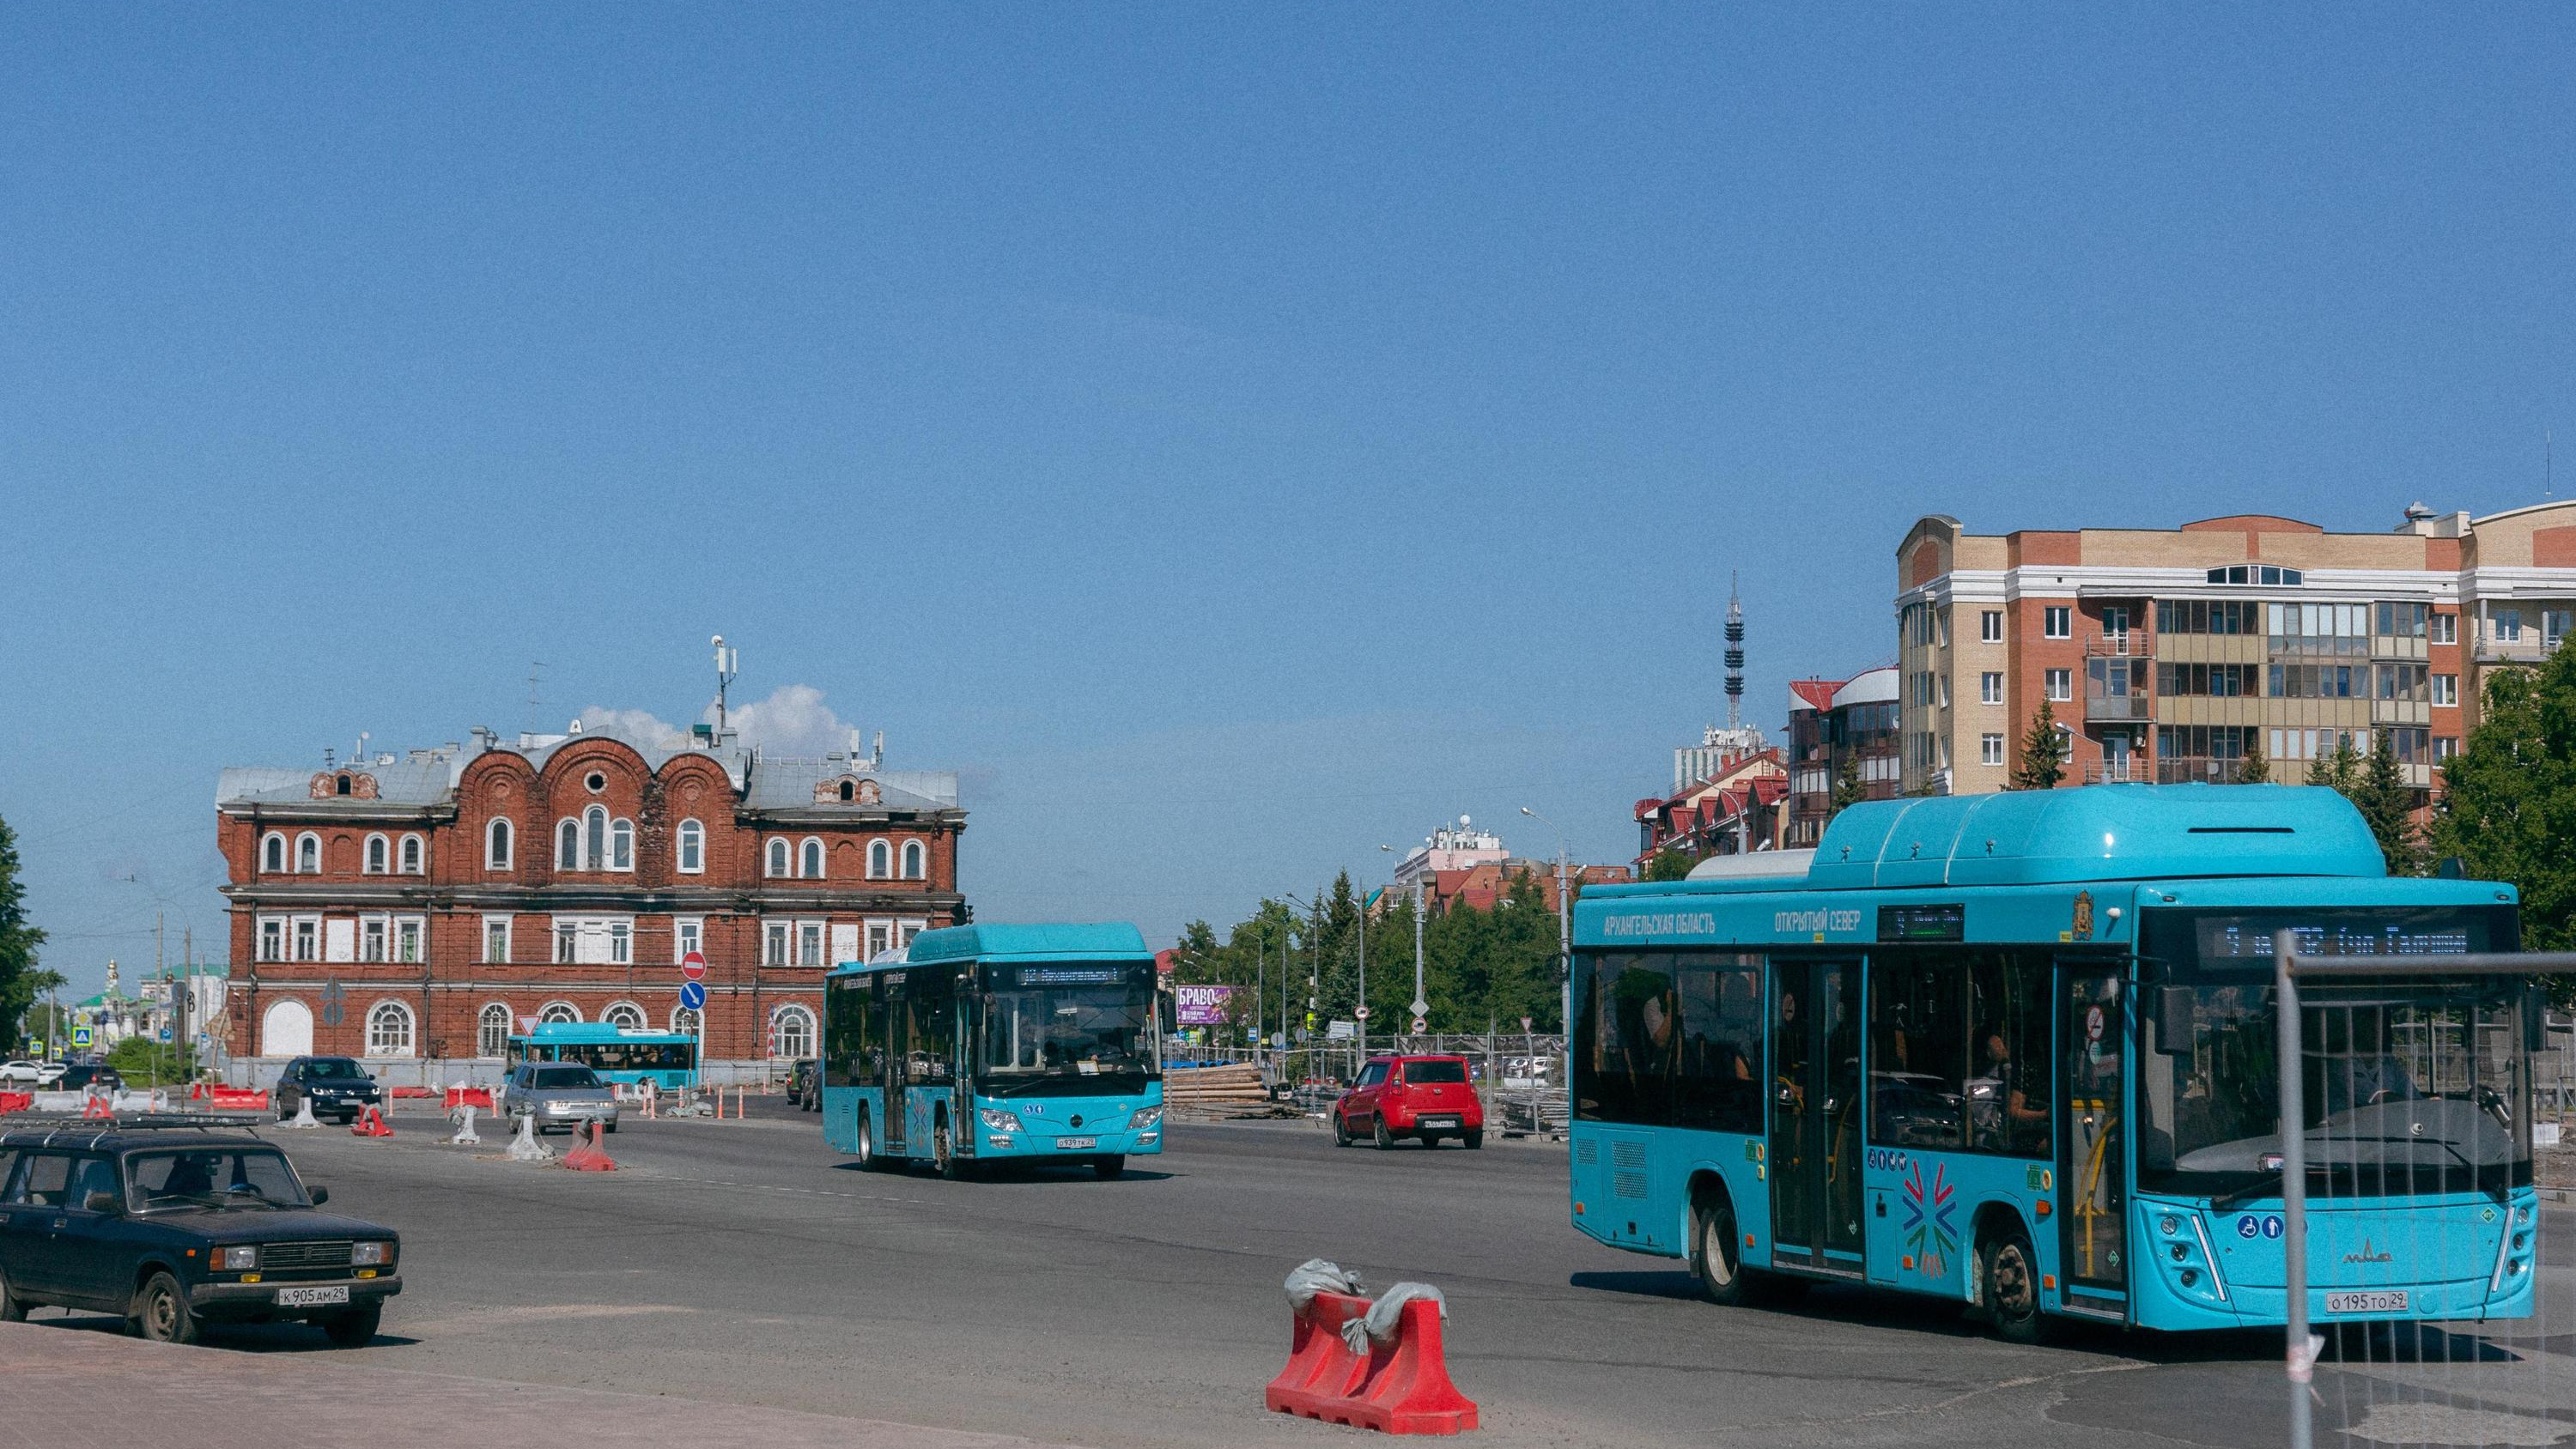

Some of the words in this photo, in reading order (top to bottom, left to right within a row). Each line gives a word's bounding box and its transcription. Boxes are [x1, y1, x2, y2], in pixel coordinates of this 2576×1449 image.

[1605, 915, 1674, 936] АРХАНГЕЛЬСКАЯ
[1676, 913, 1715, 933] ОБЛАСТЬ
[1776, 907, 1827, 932] ОТКРЫТЫЙ
[1830, 911, 1861, 931] СЕВЕР
[1179, 988, 1214, 1005] БРАВО
[333, 1288, 344, 1298] 29
[2391, 1293, 2403, 1305] 29
